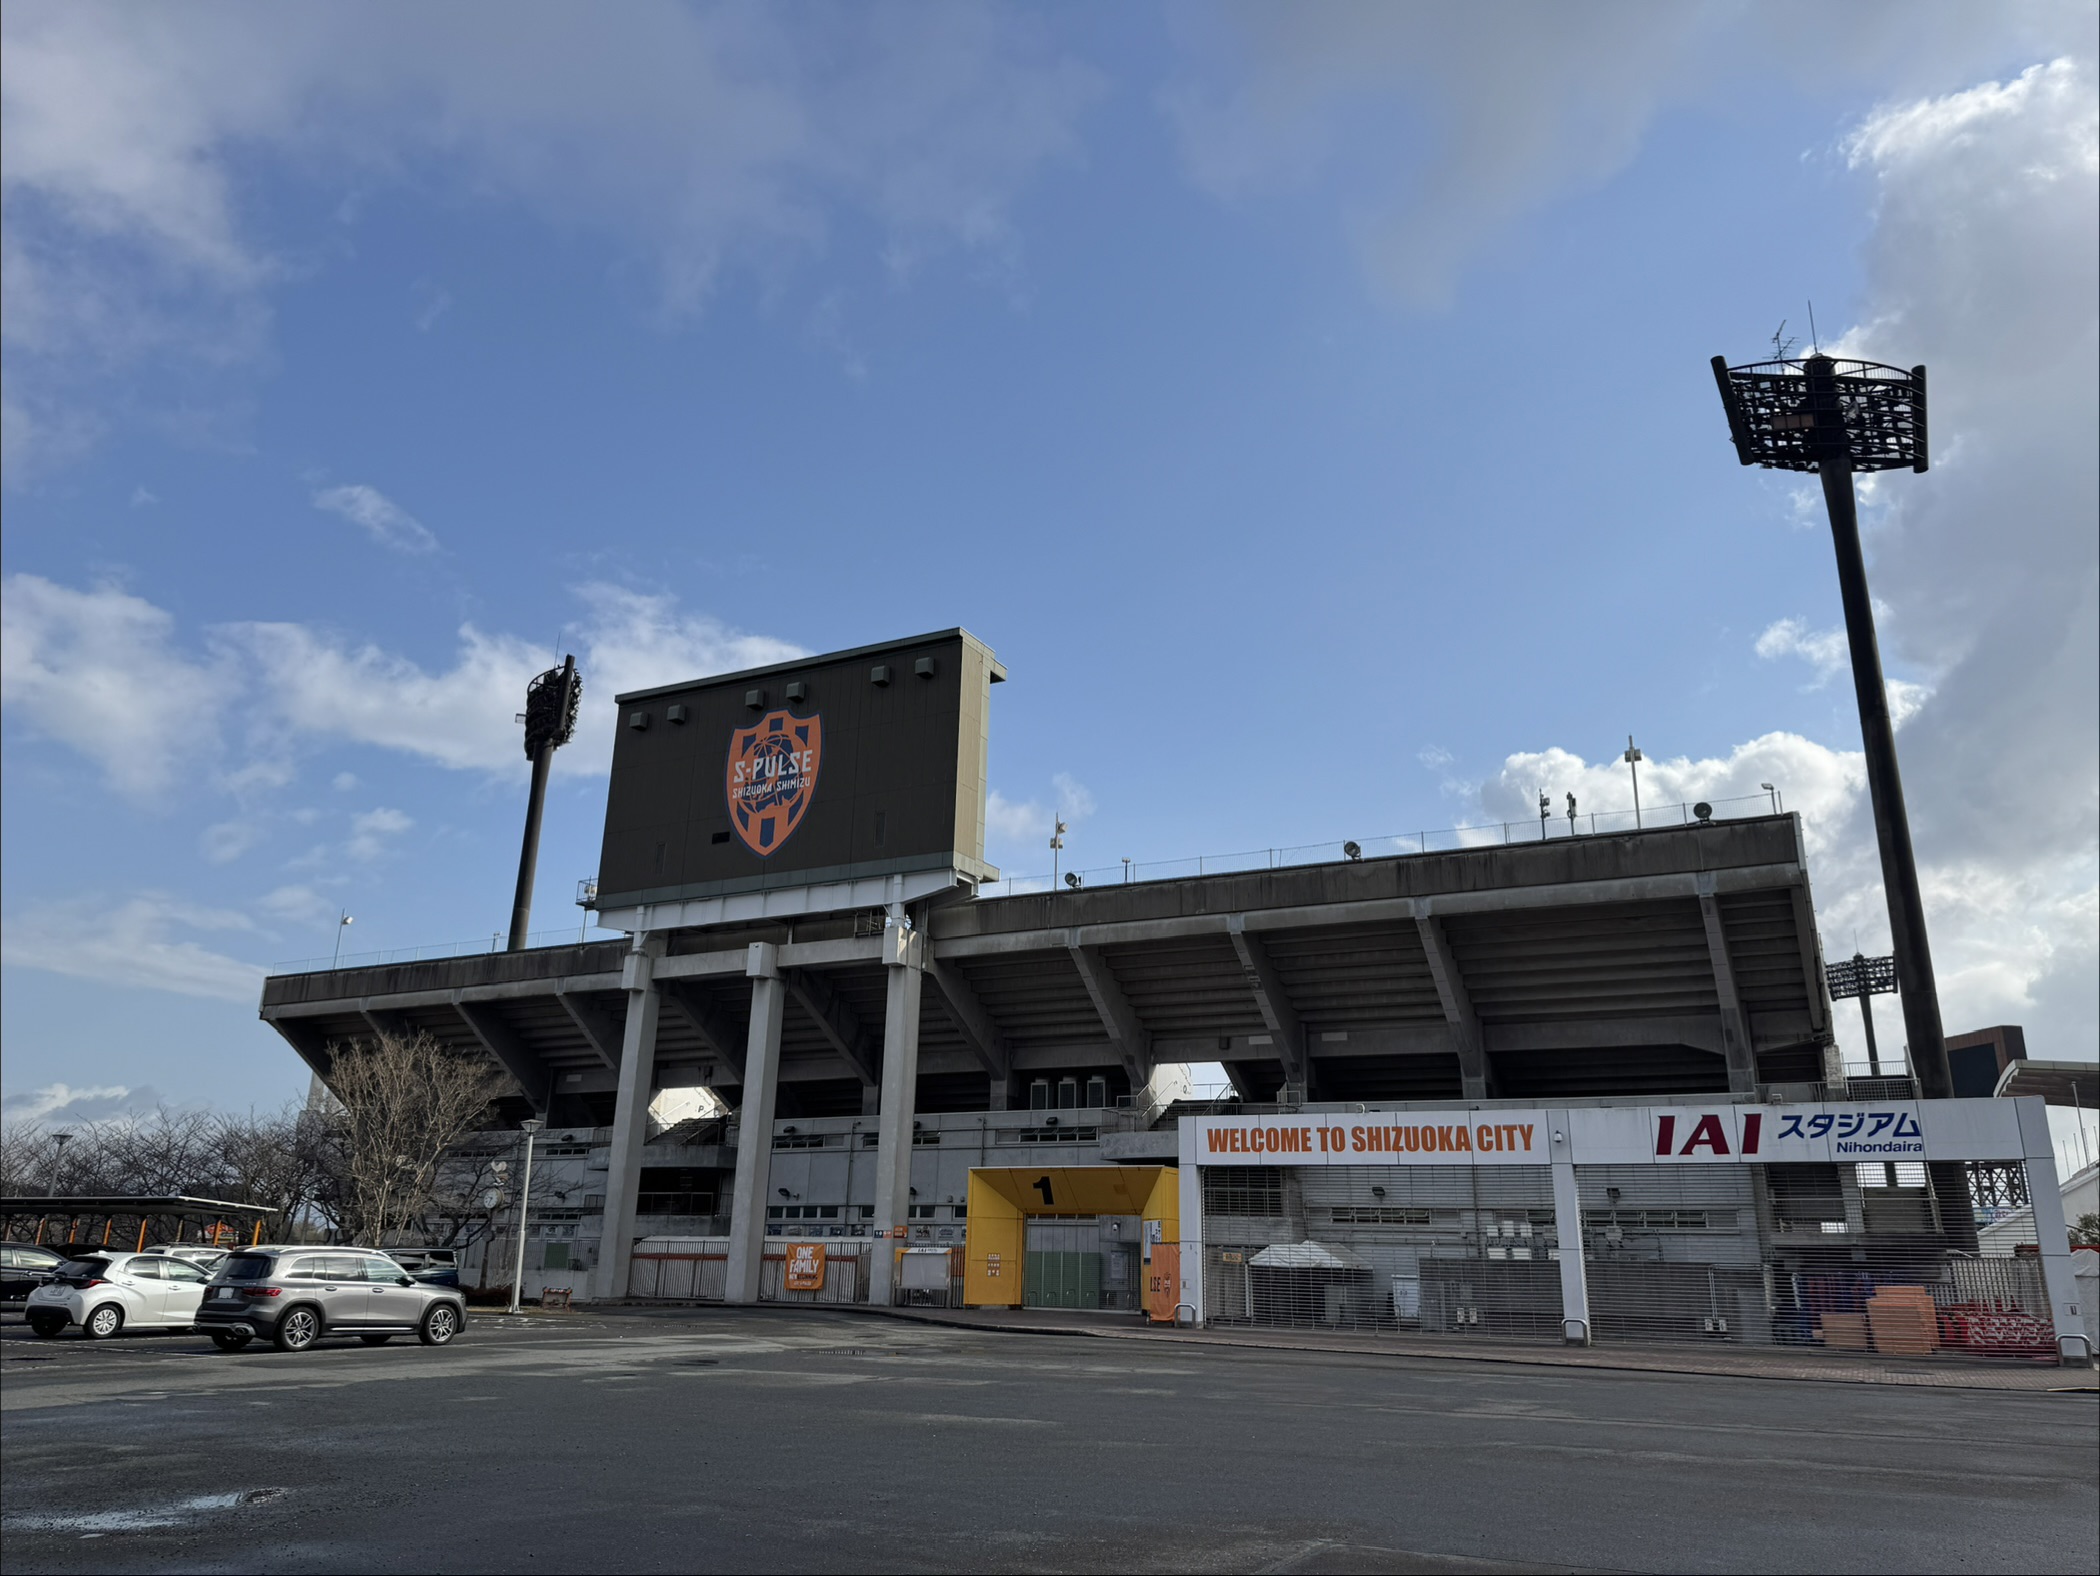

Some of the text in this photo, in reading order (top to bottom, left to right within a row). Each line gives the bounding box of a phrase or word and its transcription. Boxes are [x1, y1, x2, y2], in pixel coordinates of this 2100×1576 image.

[733, 749, 813, 783] S-PULSE
[732, 776, 811, 799] SHIZUOKA SHIMIZU
[1207, 1124, 1534, 1153] WELCOME TO SHIZUOKA CITY
[1655, 1112, 1922, 1156] IAI スタジアム
[1836, 1141, 1923, 1154] Nihondaira
[1032, 1175, 1055, 1205] 1
[796, 1246, 814, 1259] ONE
[789, 1259, 819, 1274] FAMILY
